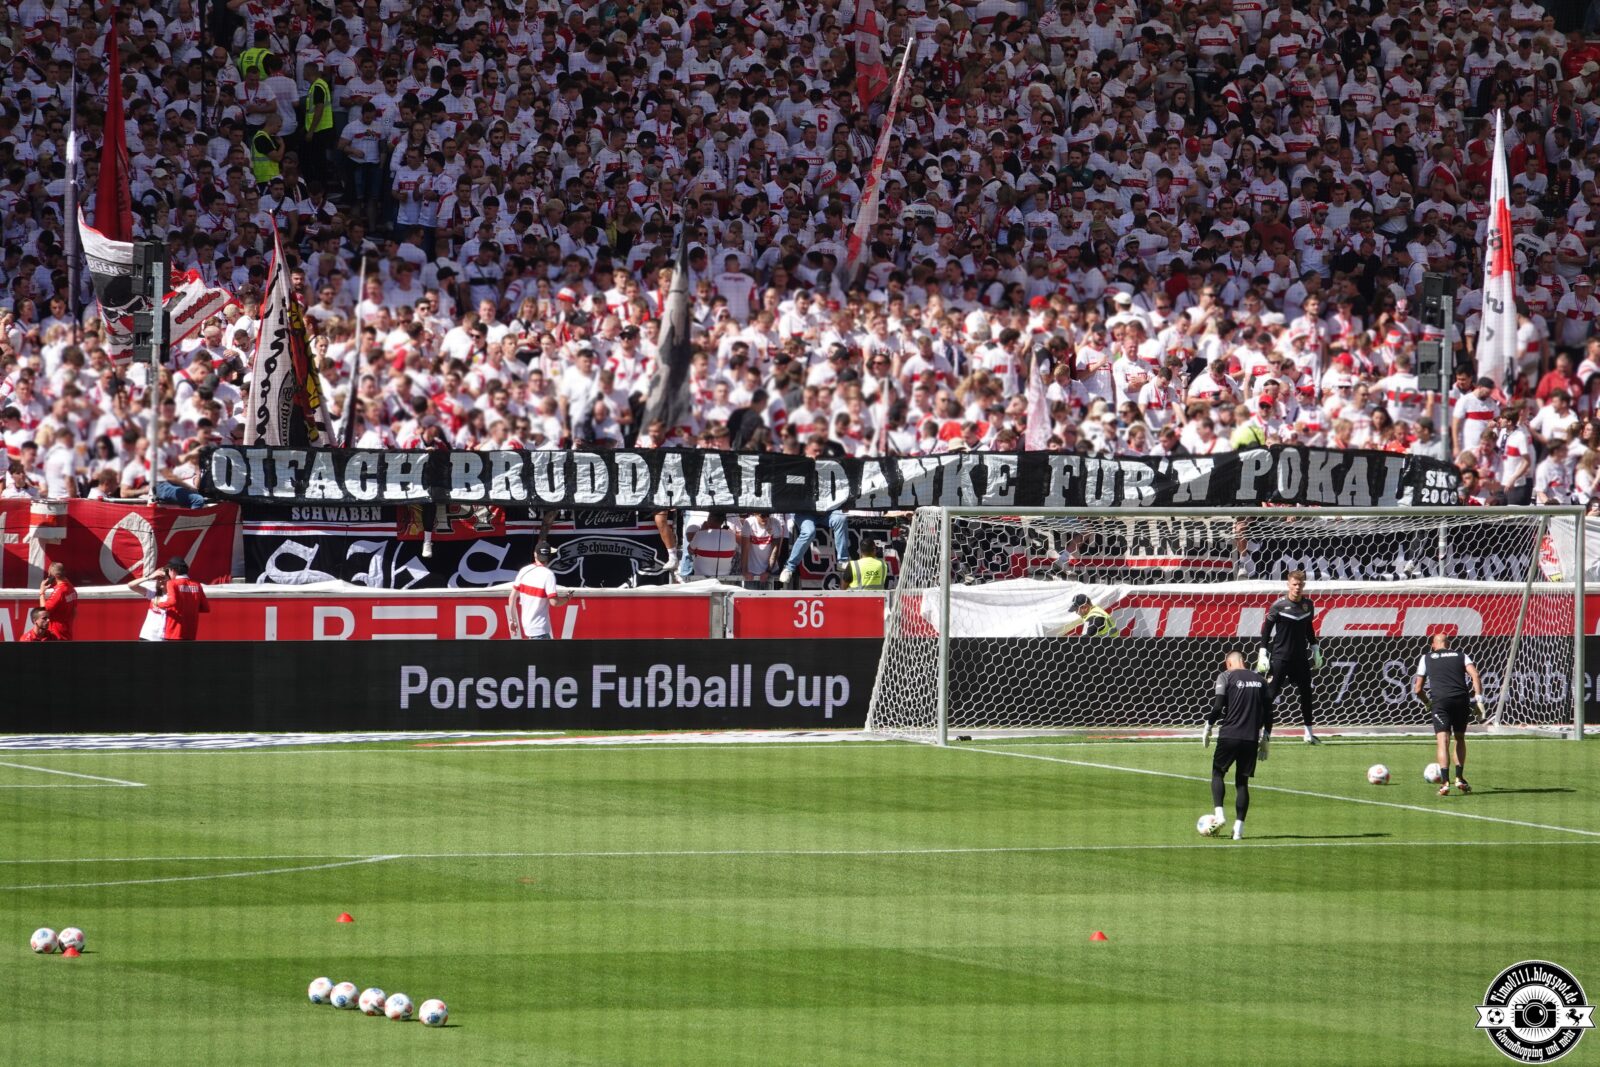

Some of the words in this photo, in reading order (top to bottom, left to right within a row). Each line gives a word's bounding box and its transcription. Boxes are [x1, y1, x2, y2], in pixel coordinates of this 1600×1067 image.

[817, 113, 828, 132] 6
[212, 448, 430, 501] OIFACH
[450, 451, 772, 508] BRUDDAAL
[815, 453, 1018, 512] DANKE
[1236, 447, 1413, 507] POKAL
[1425, 470, 1457, 489] SKS
[291, 506, 382, 521] SCHWABEN
[577, 543, 634, 557] Schwaben
[793, 600, 824, 628] 36
[401, 664, 579, 710] Porsche
[592, 663, 751, 709] Fußball
[765, 663, 851, 719] Cup
